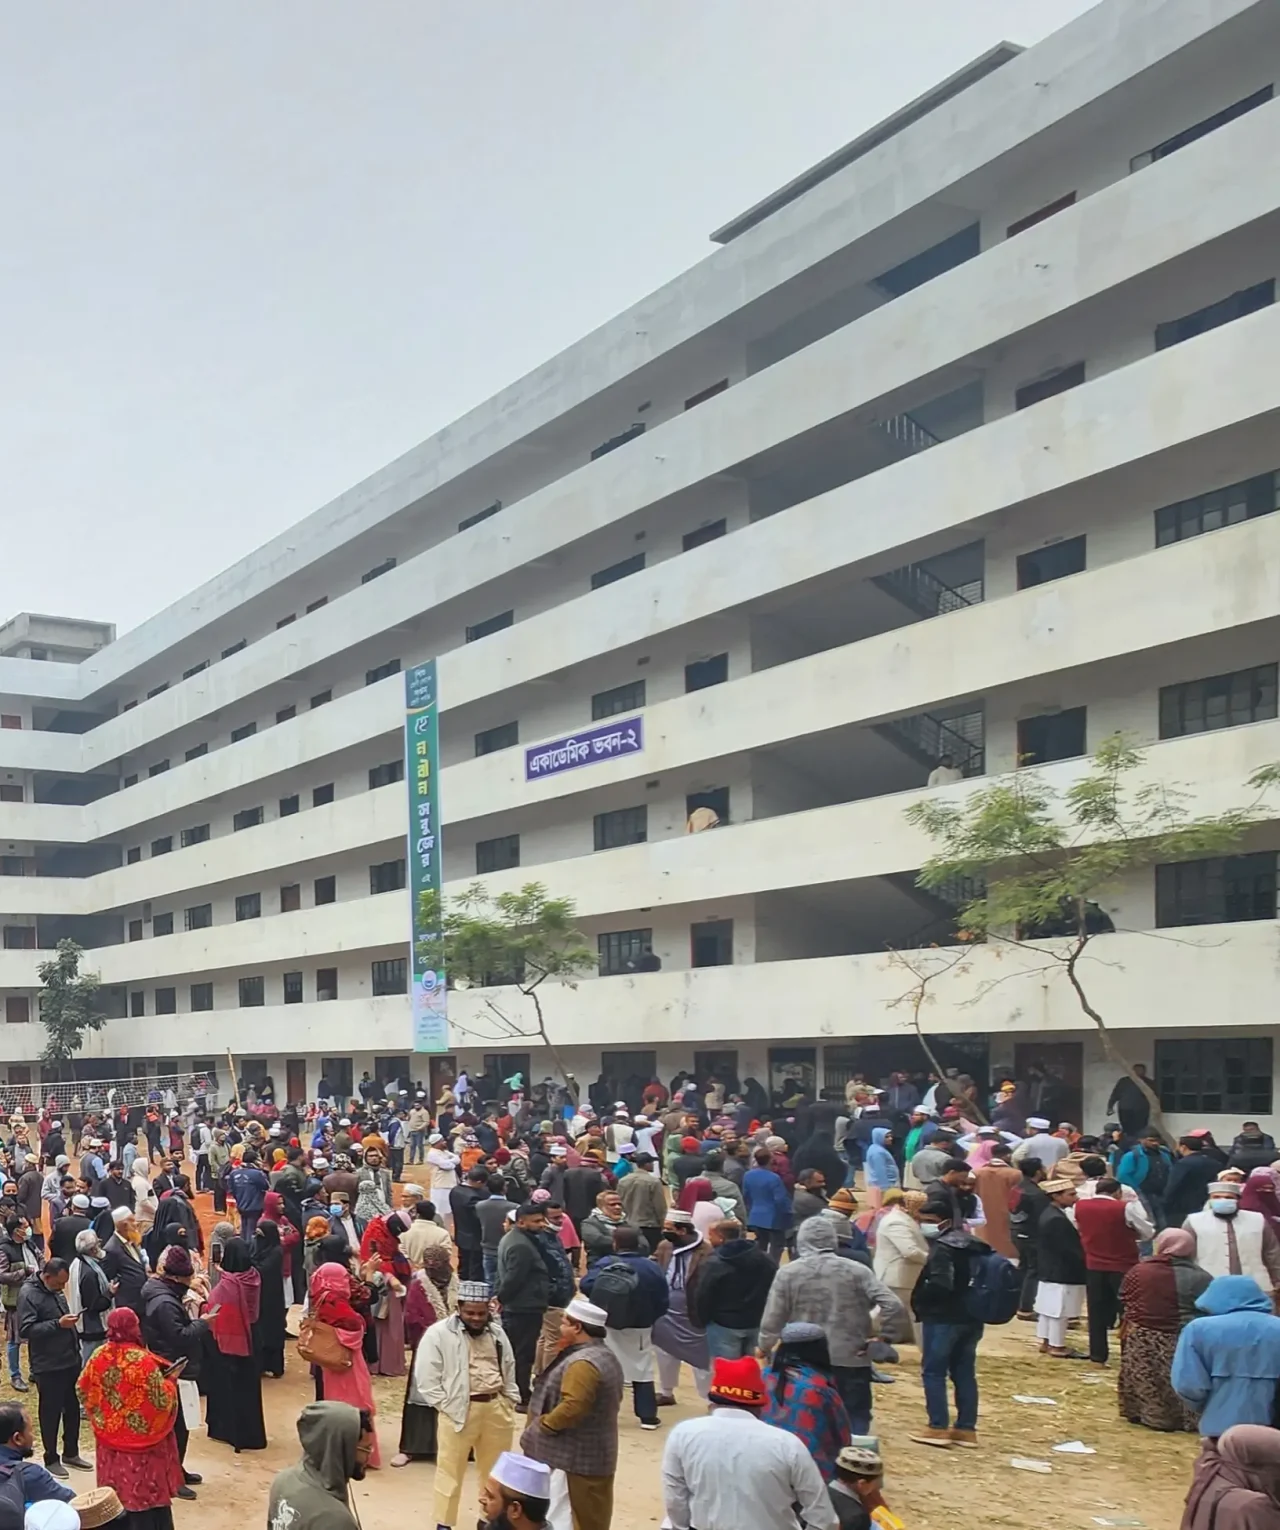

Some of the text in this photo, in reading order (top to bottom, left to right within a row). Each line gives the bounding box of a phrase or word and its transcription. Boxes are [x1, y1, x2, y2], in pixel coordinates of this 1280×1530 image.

[414, 715, 429, 735] হে
[416, 740, 430, 795] নবীন
[529, 728, 639, 773] একাডেমিক ভবন-২
[416, 802, 435, 867] সবুজের
